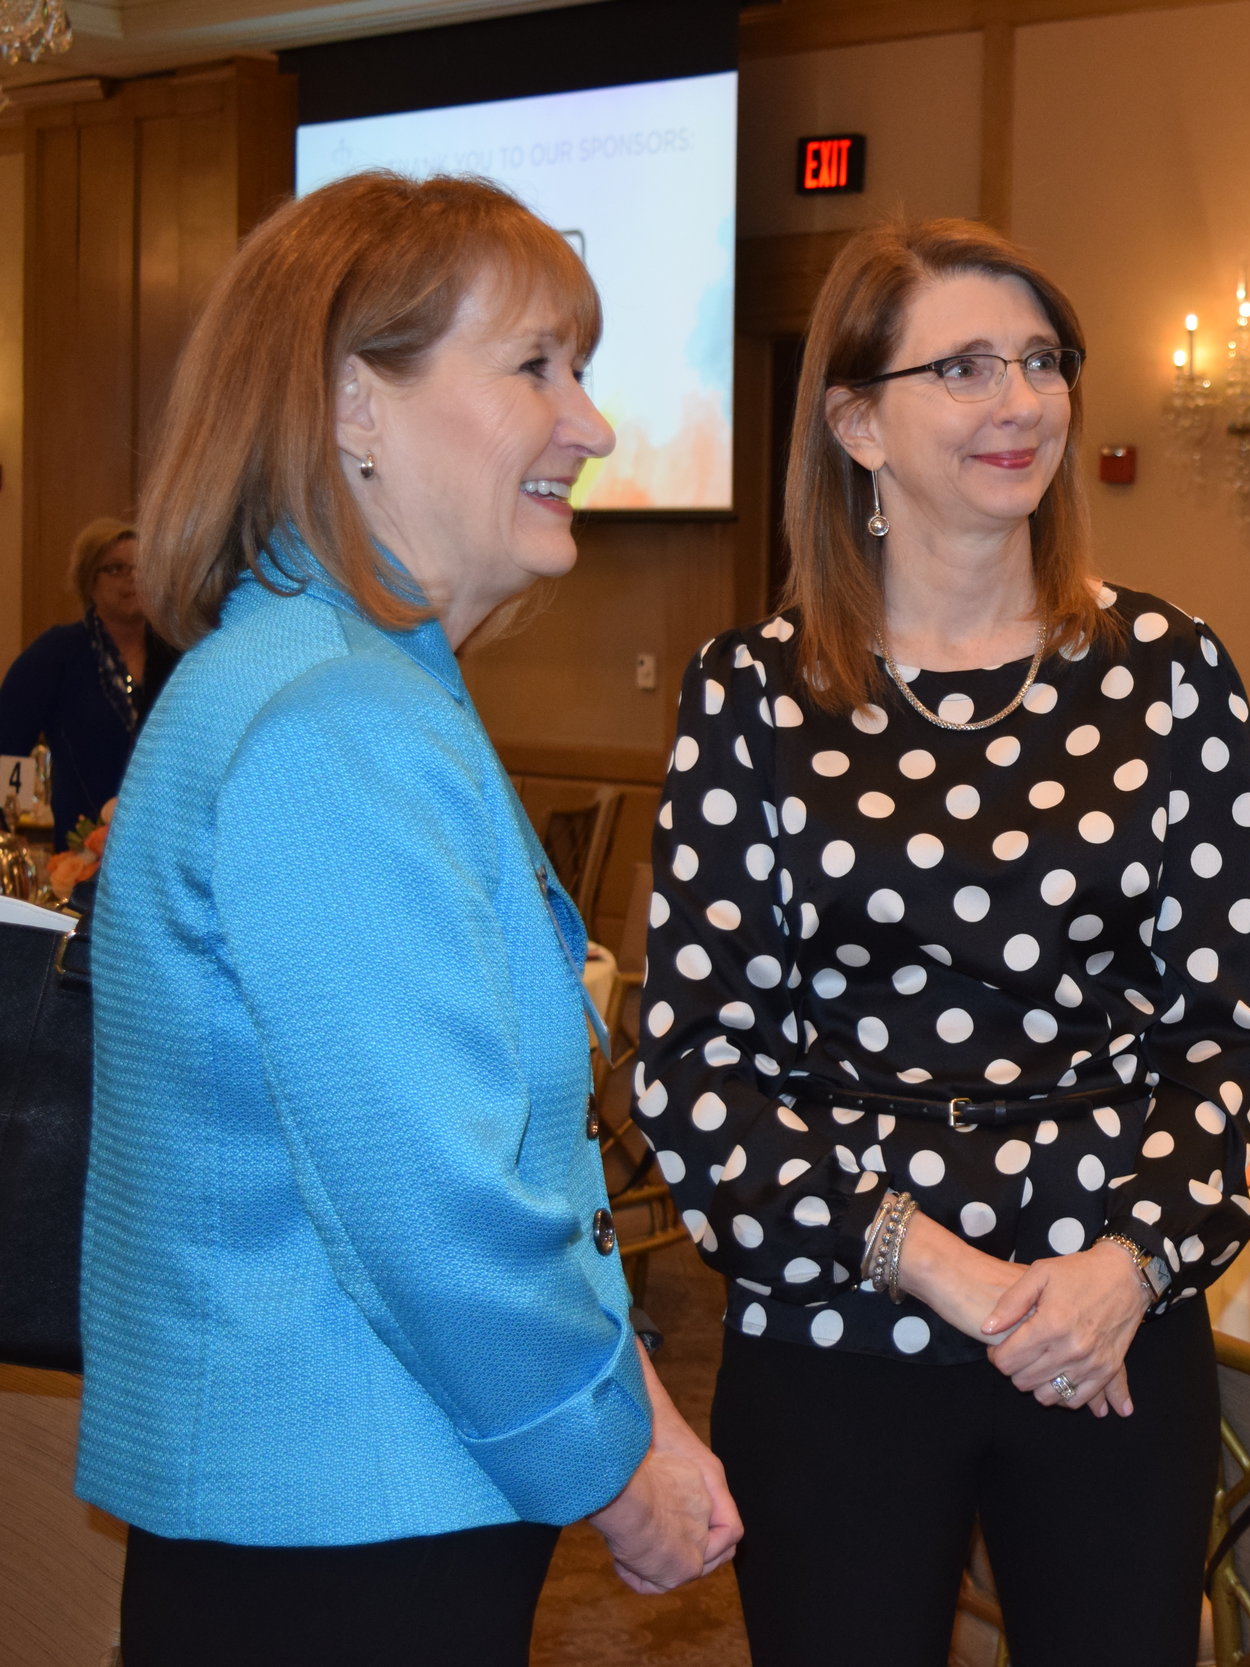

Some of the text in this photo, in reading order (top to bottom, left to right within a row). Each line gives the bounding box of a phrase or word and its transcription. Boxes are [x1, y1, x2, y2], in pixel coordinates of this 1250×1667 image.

[454, 147, 492, 171] YOU
[500, 144, 525, 168] TO
[530, 140, 572, 166] OUR
[579, 126, 695, 162] SPONSORS:
[804, 139, 852, 189] EXIT
[9, 761, 22, 794] 4
